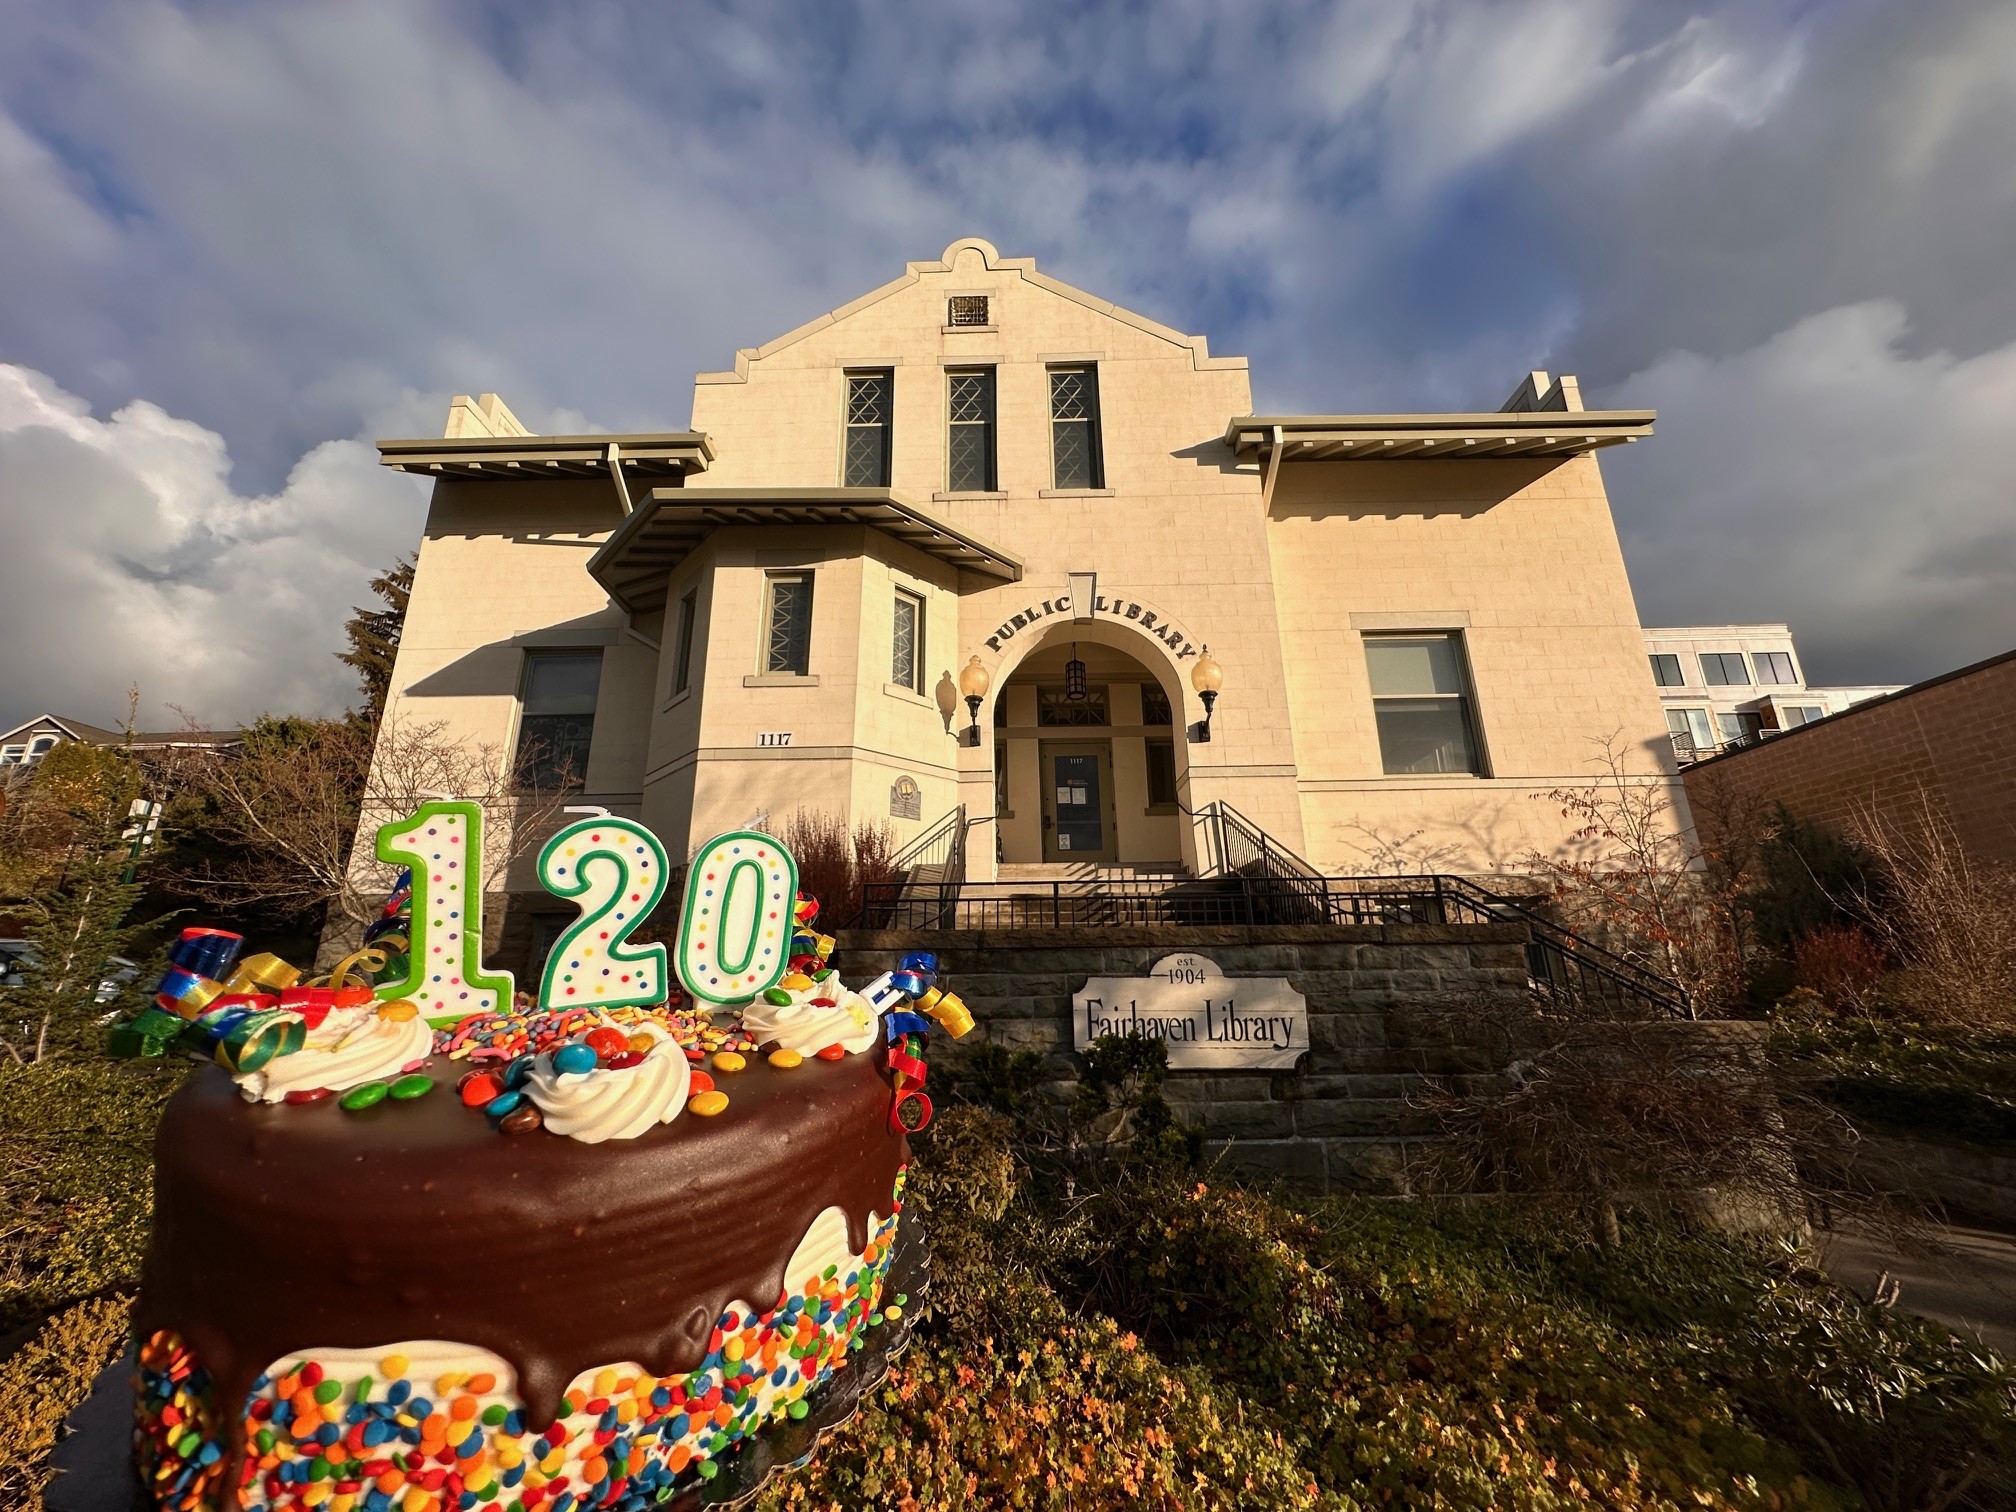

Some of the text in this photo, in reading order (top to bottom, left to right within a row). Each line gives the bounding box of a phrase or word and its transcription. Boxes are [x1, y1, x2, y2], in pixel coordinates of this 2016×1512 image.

[984, 595, 1197, 660] PUBLIC LIBRARY
[759, 733, 792, 746] 1117
[375, 800, 800, 1030] 120
[1169, 968, 1206, 984] 1904
[1085, 998, 1294, 1050] Fairhaven Library
